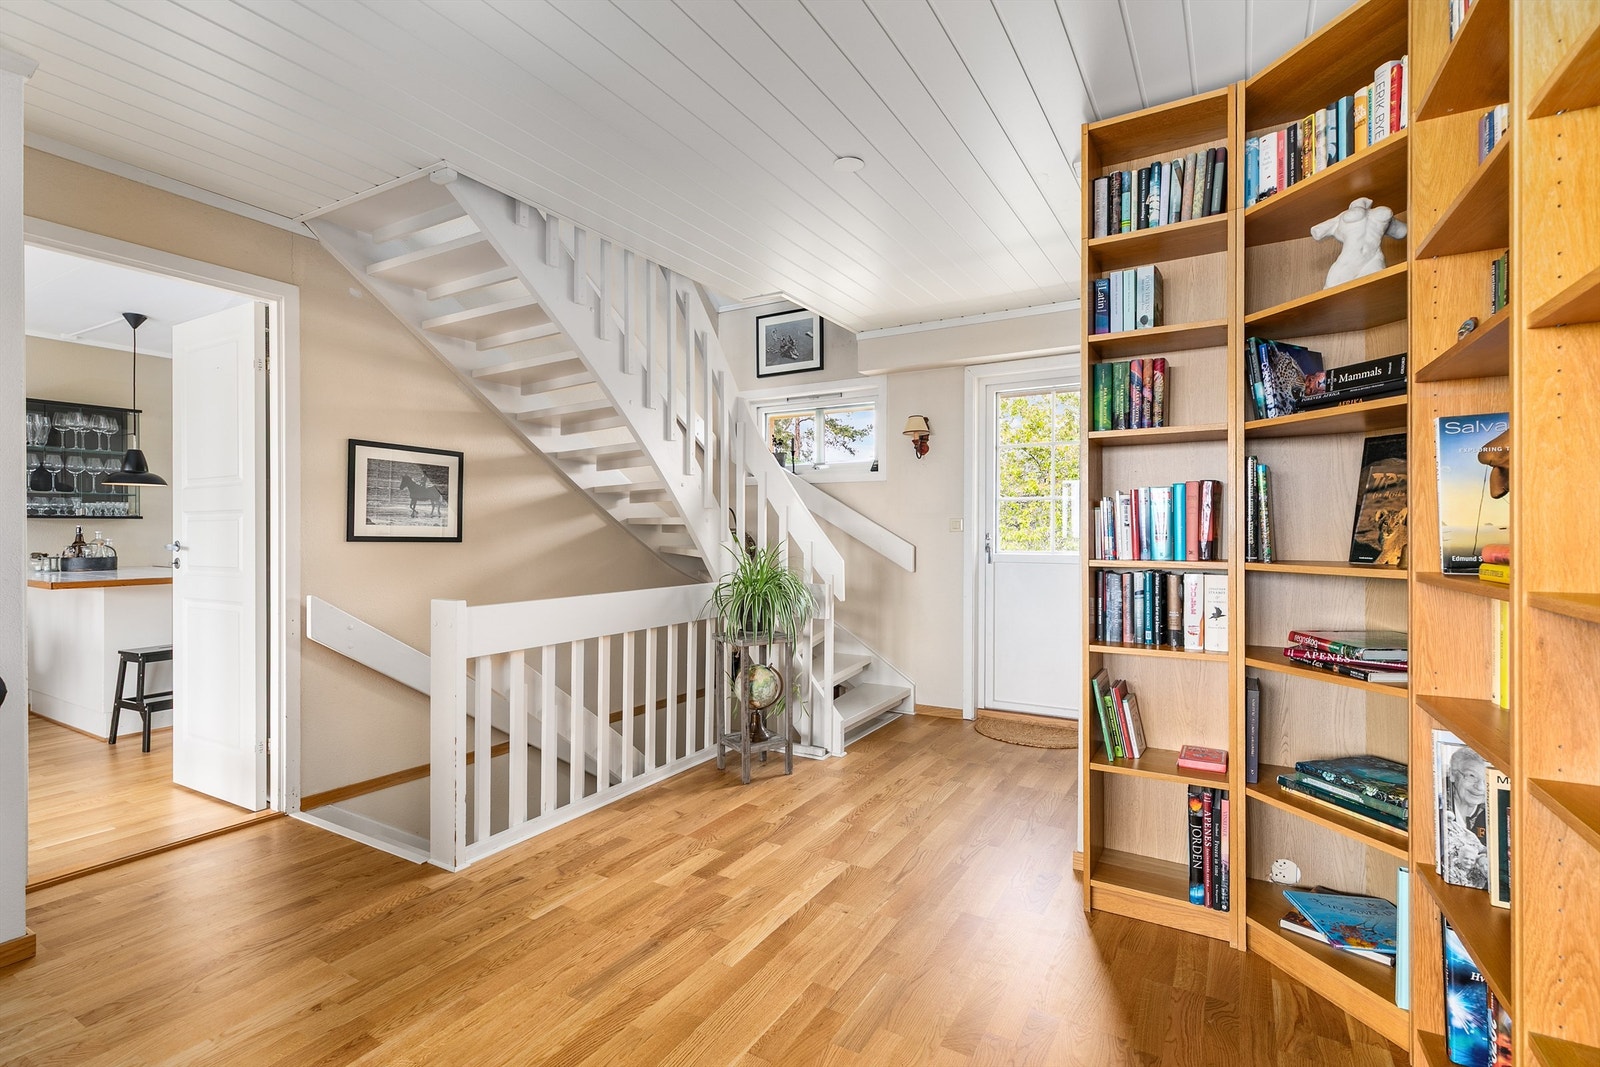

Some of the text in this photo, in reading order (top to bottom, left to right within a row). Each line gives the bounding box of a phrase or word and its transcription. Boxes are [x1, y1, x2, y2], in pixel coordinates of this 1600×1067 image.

[1374, 81, 1386, 140] ERIK BYE
[1097, 287, 1107, 309] Latin
[1339, 367, 1382, 383] Mammals
[1445, 420, 1508, 434] Salva
[1304, 649, 1350, 663] APENES
[1496, 775, 1510, 784] M
[1204, 810, 1212, 847] APENES
[1190, 824, 1202, 869] JORDEN
